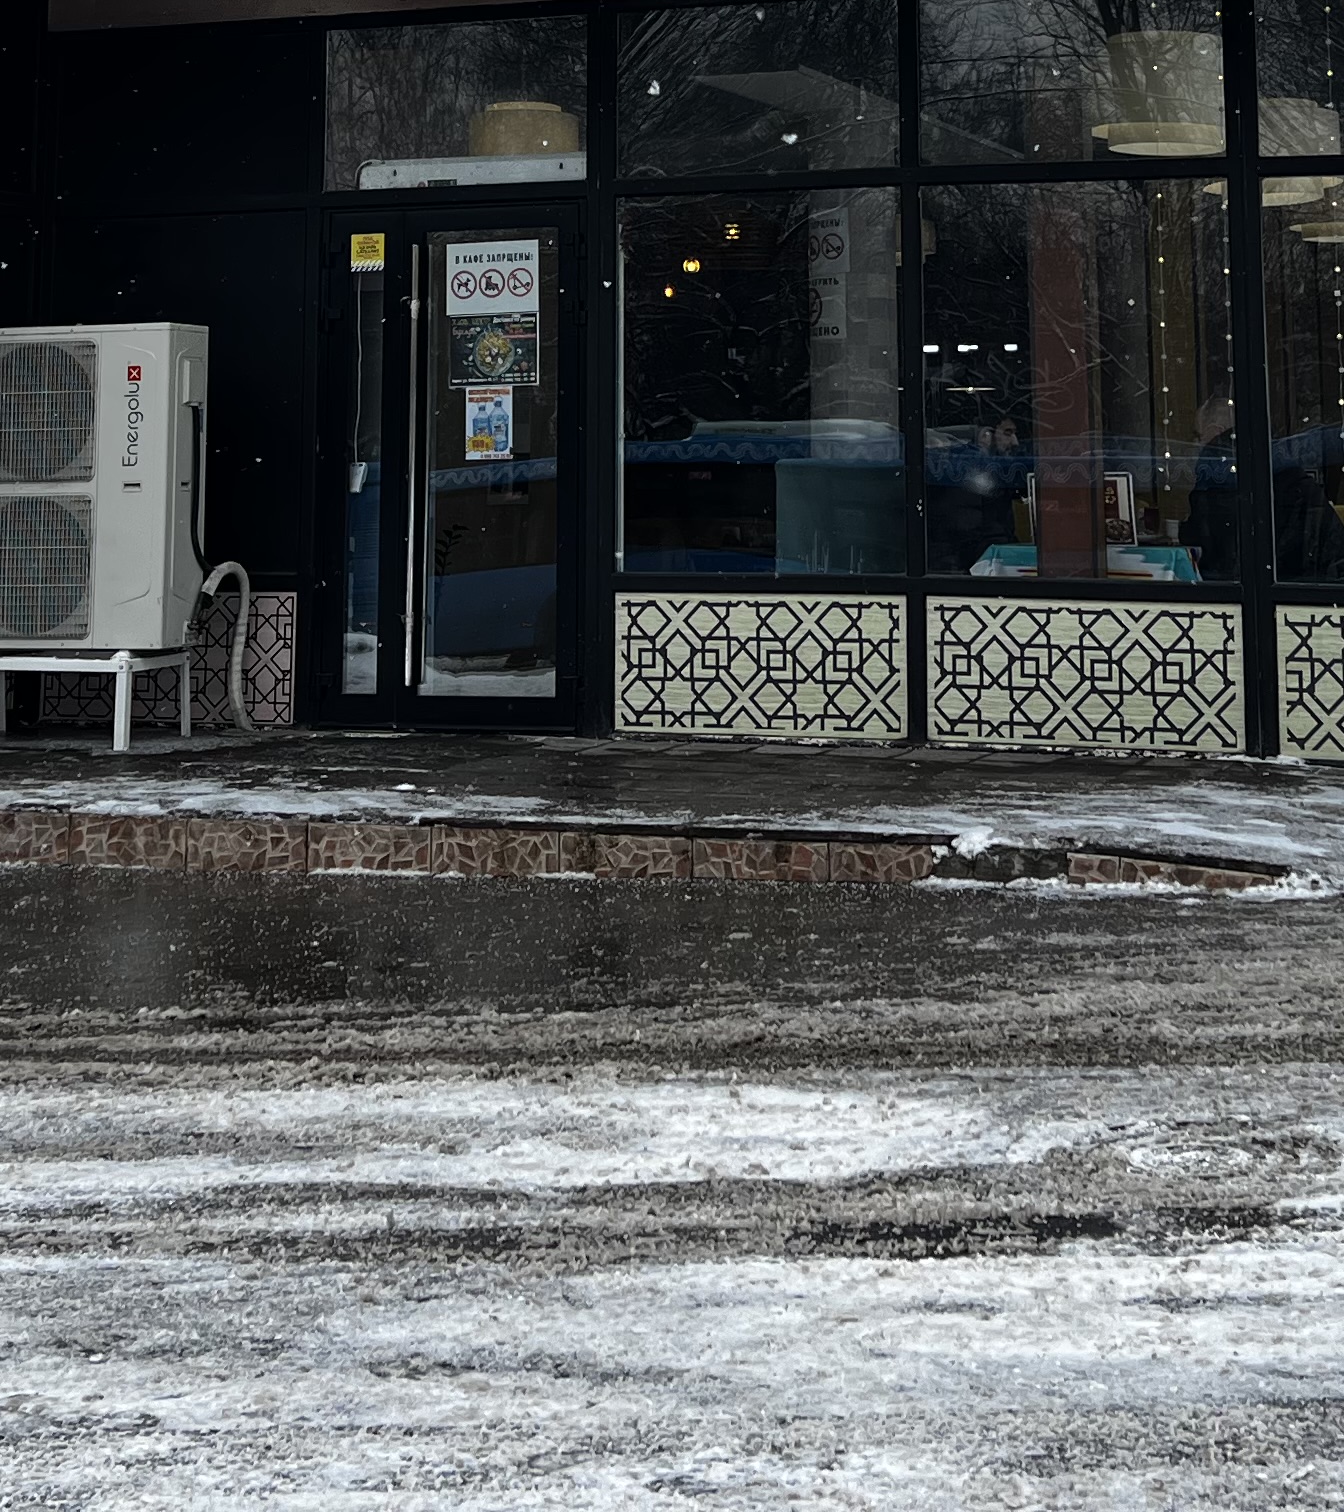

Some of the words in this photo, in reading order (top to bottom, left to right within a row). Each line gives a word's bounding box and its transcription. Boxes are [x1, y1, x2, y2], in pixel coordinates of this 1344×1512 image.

[455, 255, 460, 265] В
[462, 253, 484, 264] КАФЕ
[486, 251, 534, 263] ЗАПРЩЕНЫ:
[121, 365, 144, 467] Energolux
